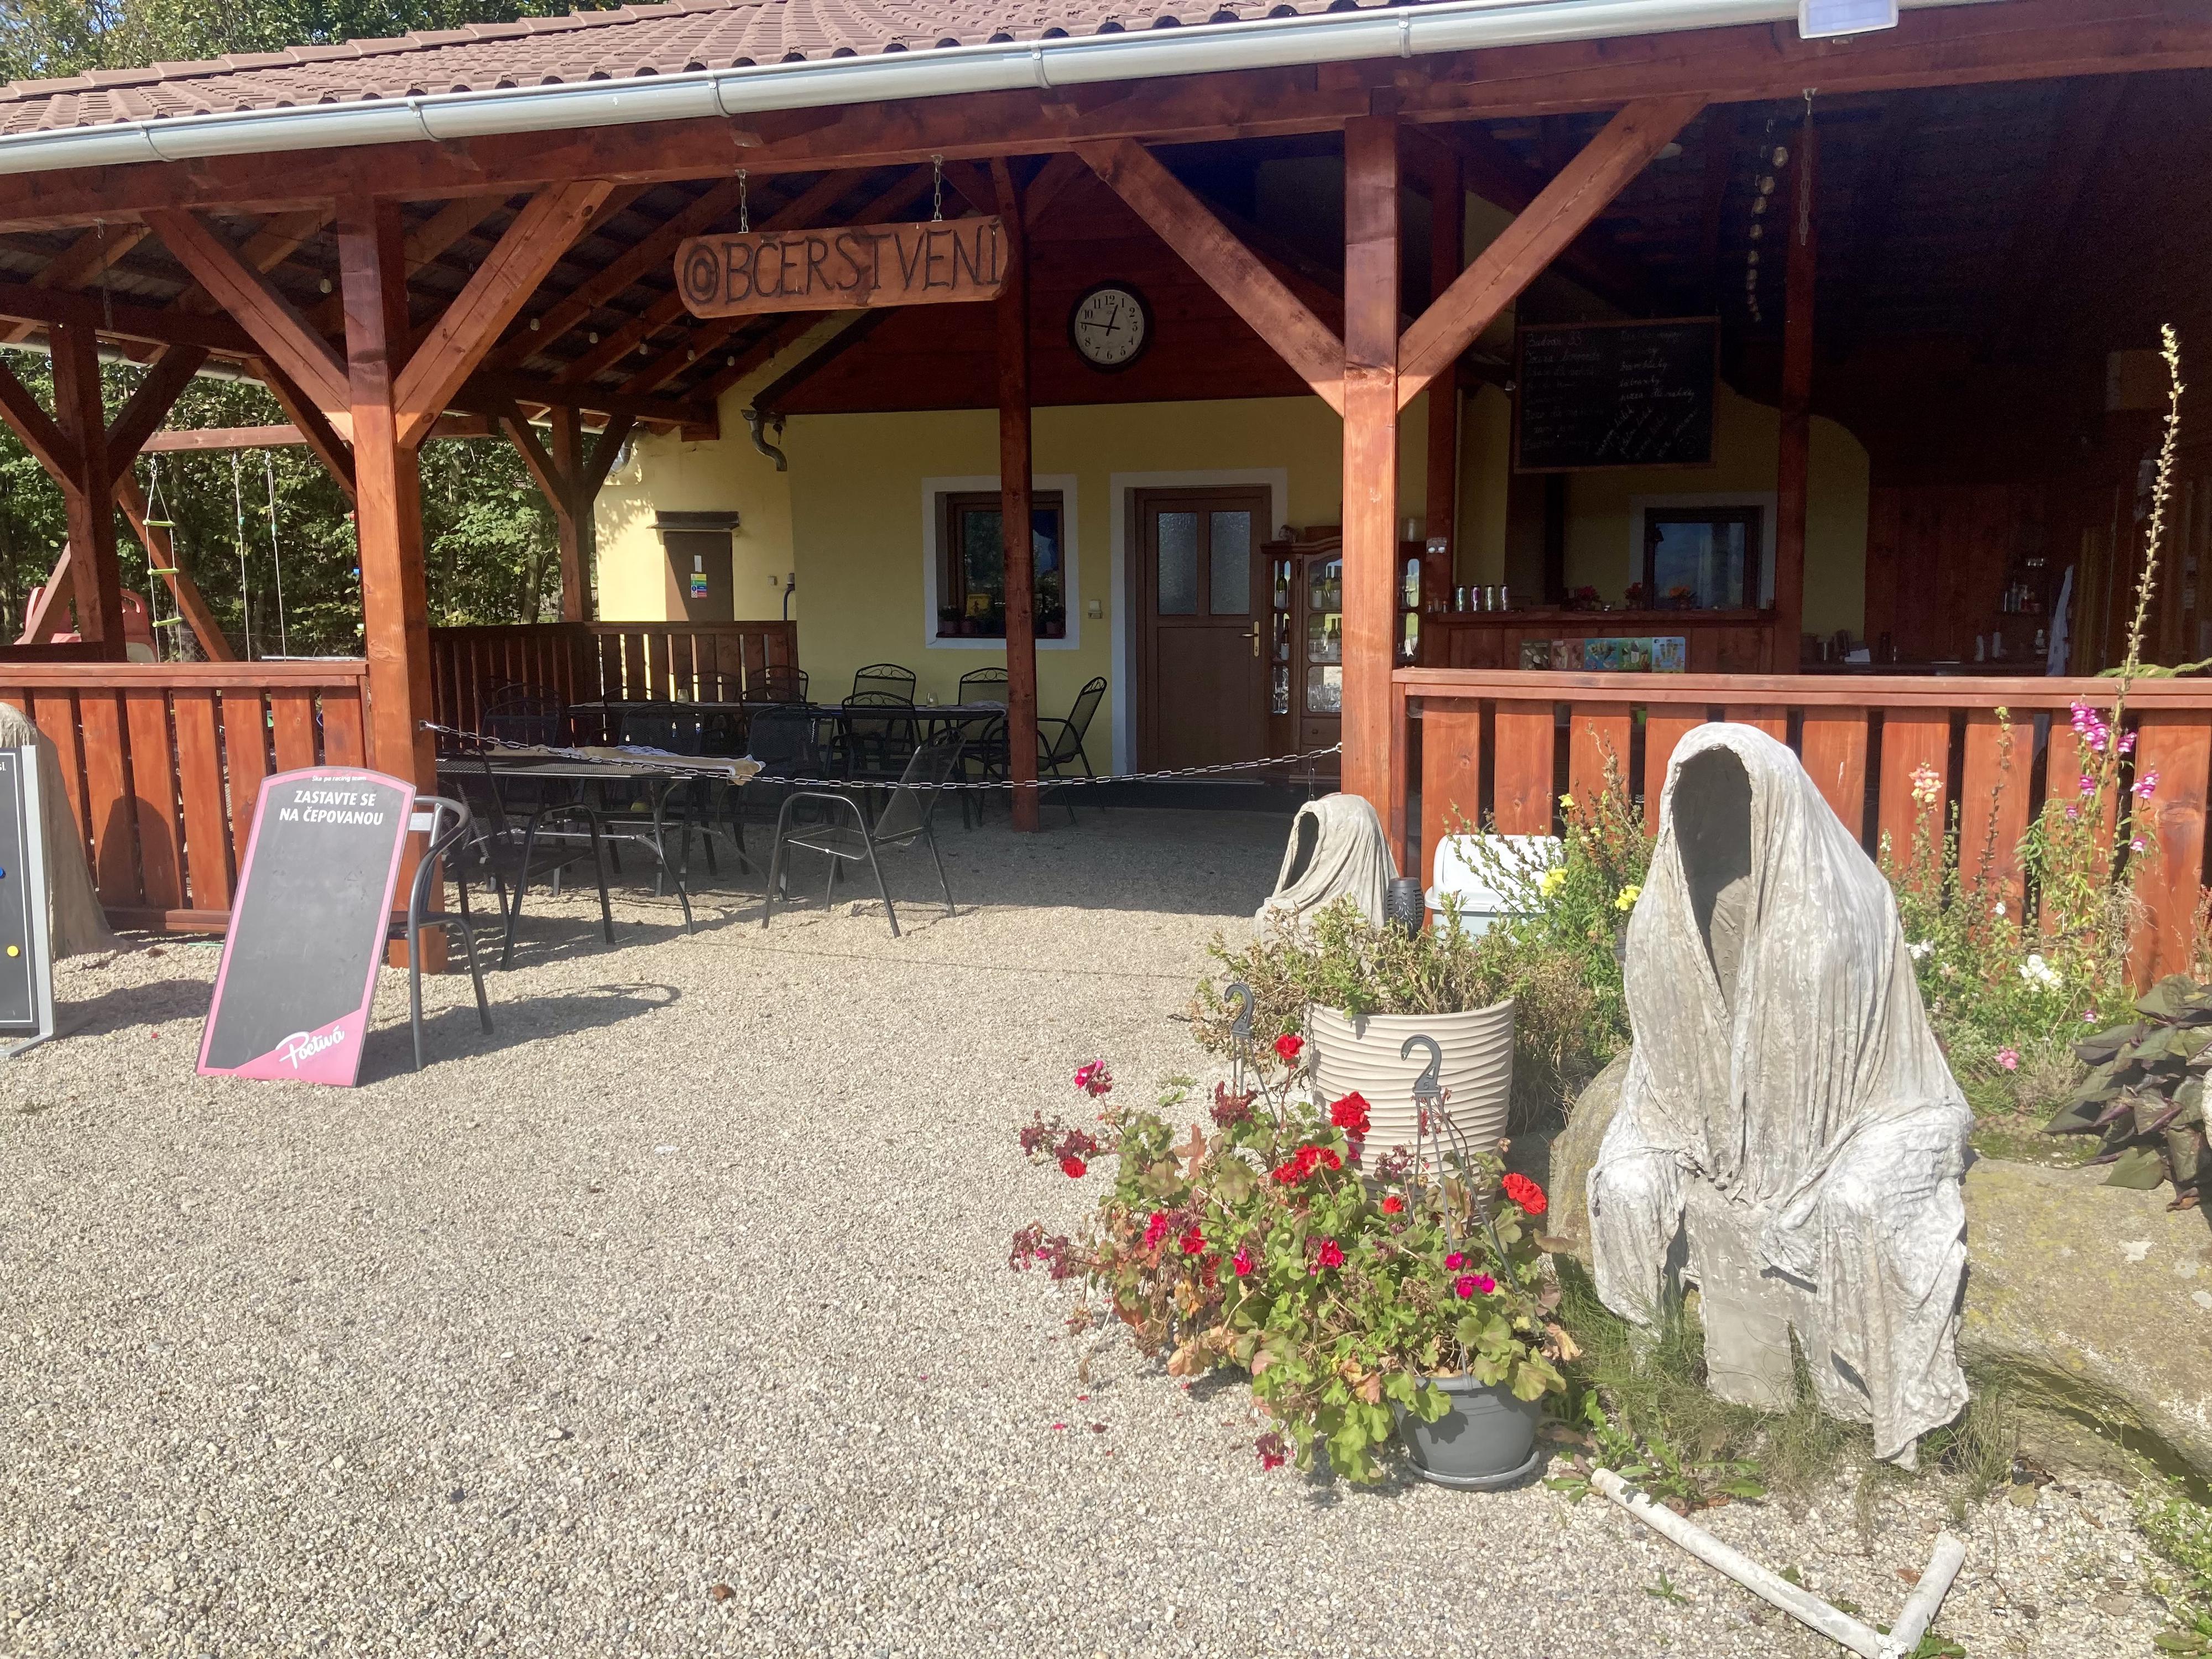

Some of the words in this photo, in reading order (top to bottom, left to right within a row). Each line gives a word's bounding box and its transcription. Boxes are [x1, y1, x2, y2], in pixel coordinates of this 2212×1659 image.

[1094, 299, 1100, 309] 11
[1105, 295, 1115, 305] 12
[1084, 310, 1093, 319] 10
[1129, 307, 1135, 317] 2
[1084, 336, 1091, 347] 8
[1128, 336, 1133, 345] 4
[1095, 347, 1100, 357] 7
[1107, 351, 1112, 359] 6
[1120, 346, 1126, 356] 5
[294, 790, 357, 806] ZASTAVTE
[360, 793, 377, 806] SE
[279, 808, 299, 821] NA
[303, 806, 384, 826] ČEPOVANOU
[275, 1025, 345, 1070] Poctivá
